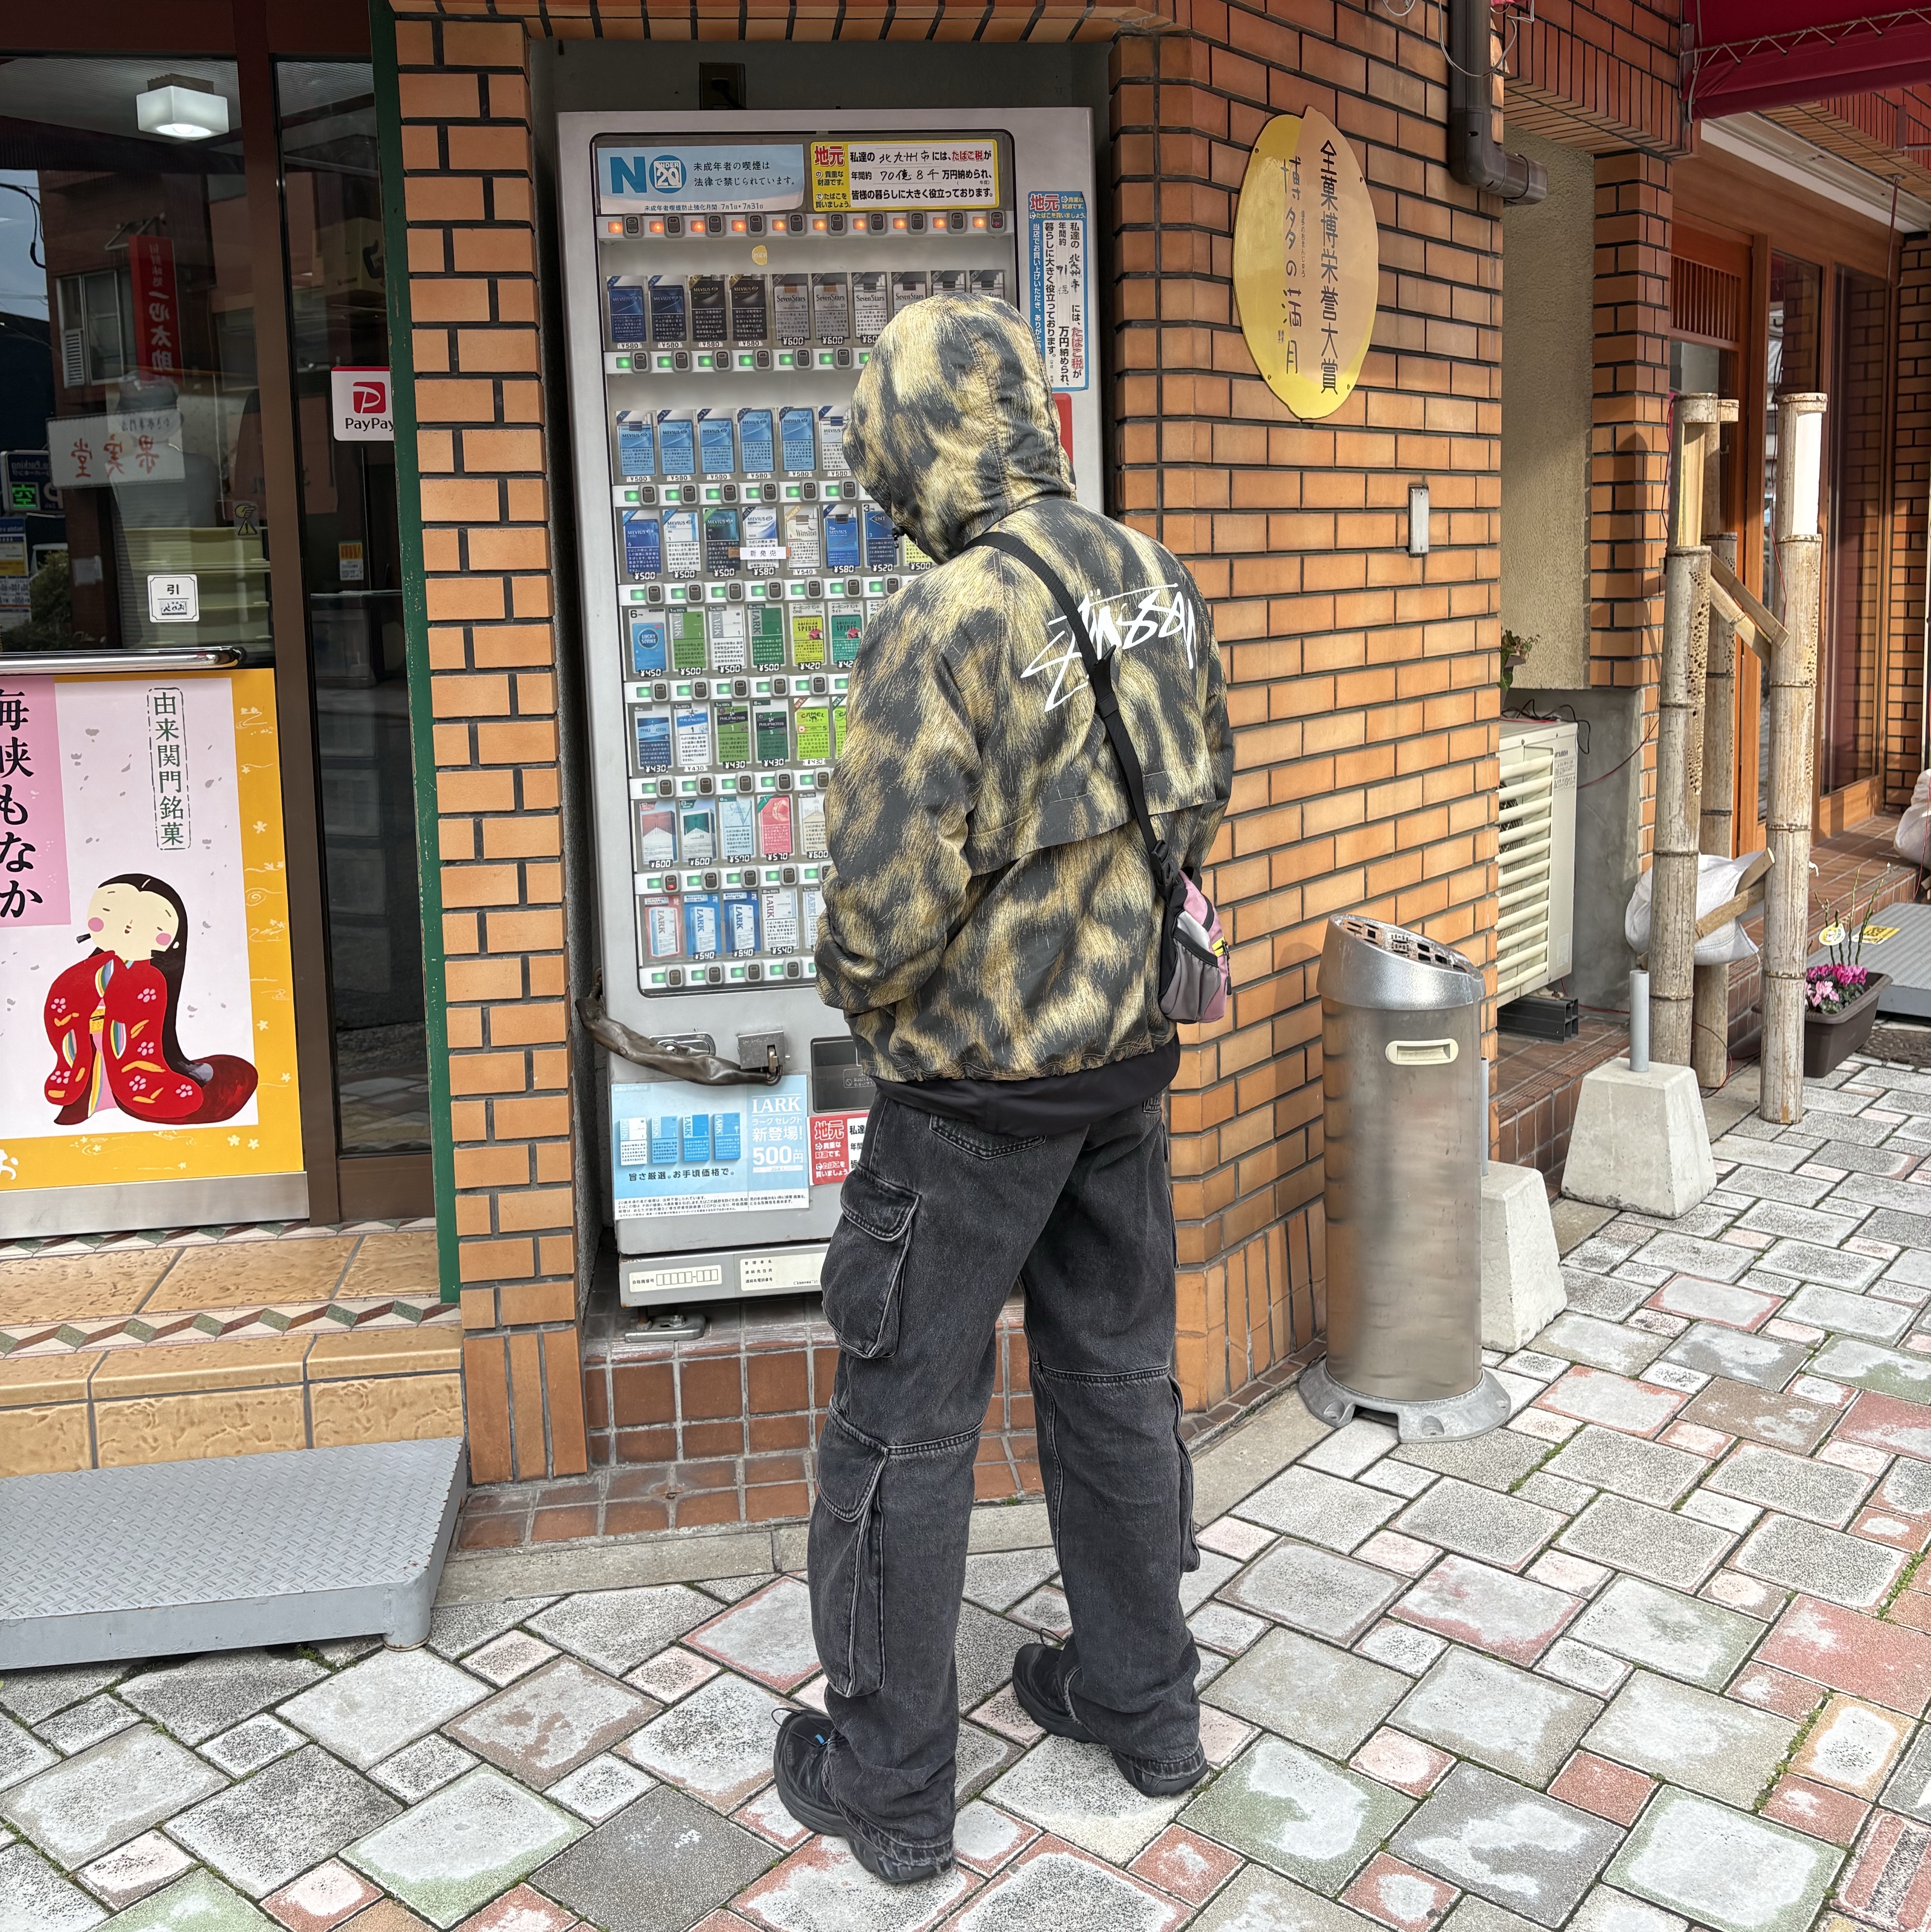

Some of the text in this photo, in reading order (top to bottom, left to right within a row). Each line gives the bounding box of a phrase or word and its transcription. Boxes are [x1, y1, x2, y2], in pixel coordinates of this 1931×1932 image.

[814, 146, 844, 166] 地元
[850, 151, 875, 162] 私達の
[693, 161, 770, 171] 未成年者の喫煙は
[851, 171, 872, 180] 年間約
[942, 169, 992, 179] 万円納められ、
[694, 176, 795, 187] 法律で禁じられています。
[851, 188, 993, 200] 皆様の暮らしに大きく役立っております。
[1030, 194, 1060, 211] 地元
[1058, 221, 1066, 247] 年間約
[1070, 222, 1080, 248] 私達の
[1321, 139, 1339, 395] 全菓博栄誉大賞
[1045, 222, 1056, 358] 暮らしに大きく役立っております。
[856, 294, 885, 302] SevenStars
[783, 337, 803, 345] ¥600
[822, 336, 843, 344] ¥600
[1058, 326, 1070, 386] 万円納められ、
[345, 418, 394, 431] PayPay
[795, 529, 817, 537] Winston
[911, 562, 931, 570] ¥500
[635, 572, 656, 580] ¥500
[714, 569, 734, 577] ¥500
[167, 583, 179, 595] 引
[752, 610, 761, 635] LARK
[680, 667, 701, 675] ¥500
[720, 665, 741, 673] ¥500
[800, 662, 821, 670] ¥420
[725, 761, 745, 769] ¥430
[764, 758, 784, 766] ¥430
[154, 692, 184, 845] 由来関門銘菓
[646, 765, 666, 773] ¥430
[651, 860, 671, 868] ¥600
[690, 858, 710, 866] ¥600
[766, 895, 775, 918] LARK
[657, 909, 665, 934] LARK
[772, 946, 792, 954] ¥540
[752, 1096, 802, 1114] LARK
[775, 1116, 802, 1124] セレクト
[814, 1120, 844, 1141] 地元
[752, 1145, 803, 1165] 500円
[629, 1167, 734, 1182] 旨さ厳選。お手頃価格で。
